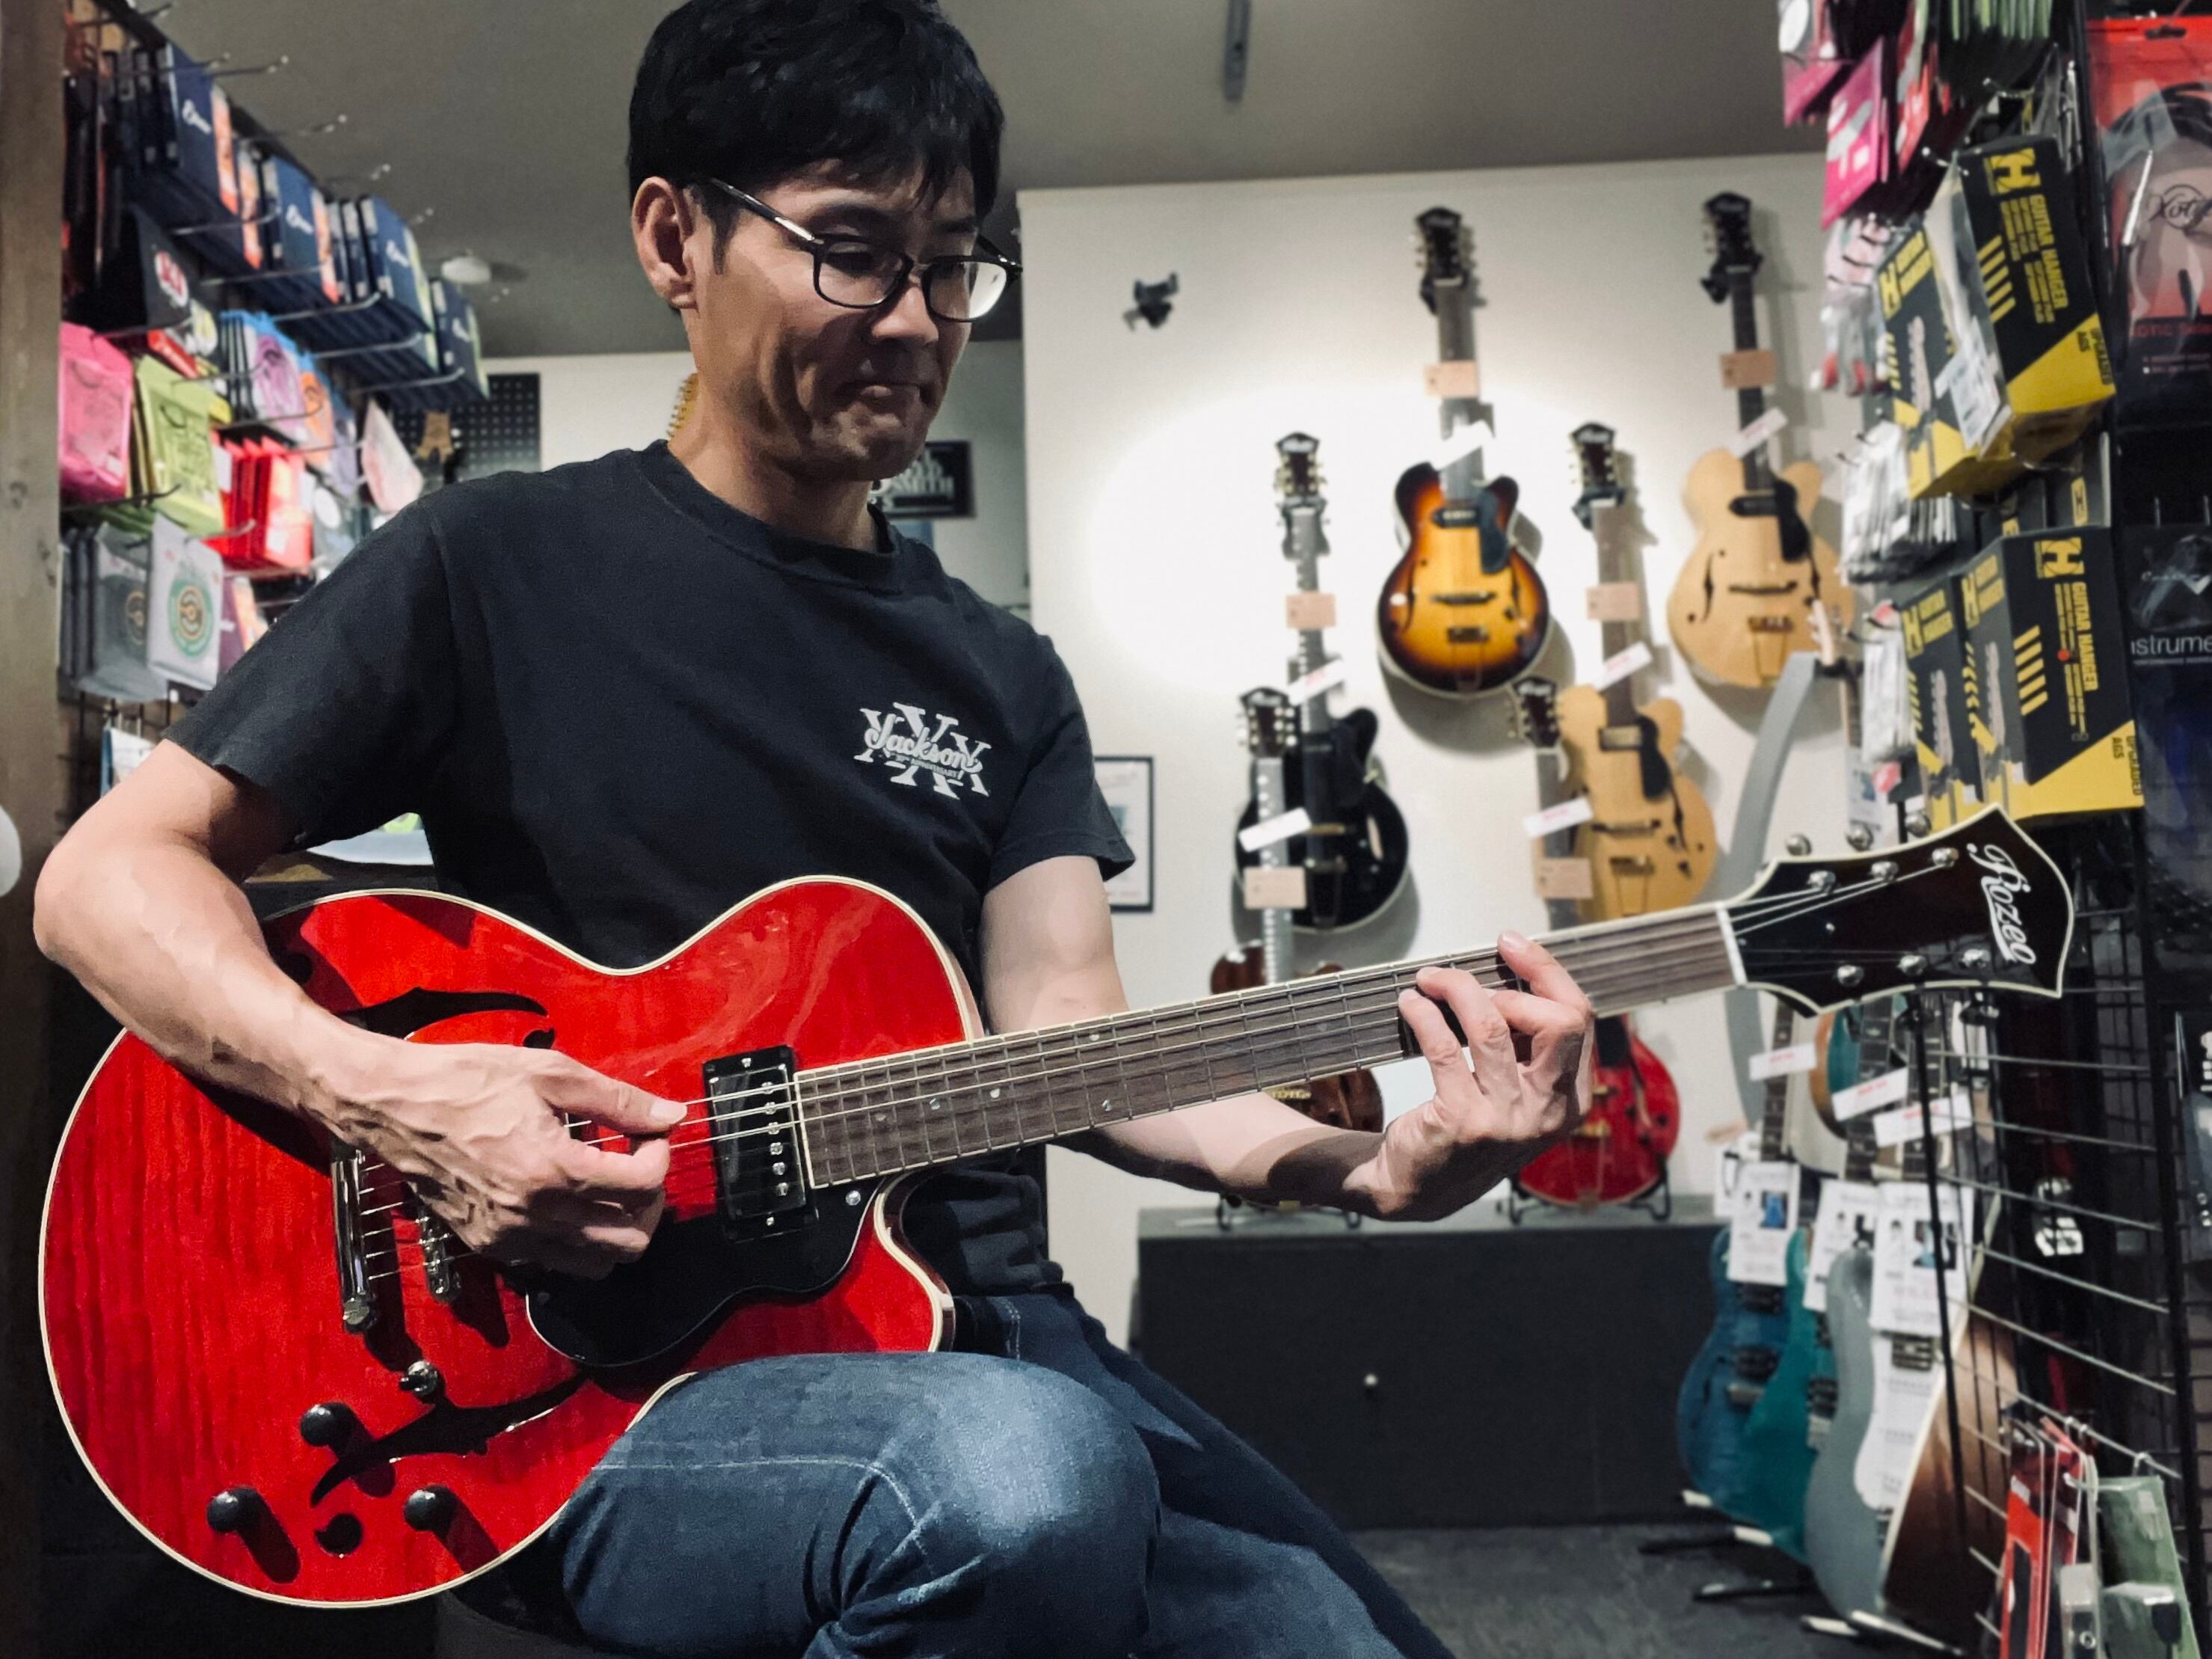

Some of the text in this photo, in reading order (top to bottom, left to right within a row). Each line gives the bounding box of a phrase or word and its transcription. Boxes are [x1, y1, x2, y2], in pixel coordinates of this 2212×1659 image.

[2030, 194, 2054, 246] GUITAR
[2042, 249, 2068, 310] HANGER
[2072, 581, 2099, 691] GUITAR HANGER
[2131, 634, 2212, 655] strume
[864, 713, 983, 773] Jackson
[2112, 736, 2124, 759] AGS
[1967, 844, 2037, 964] Rozeo
